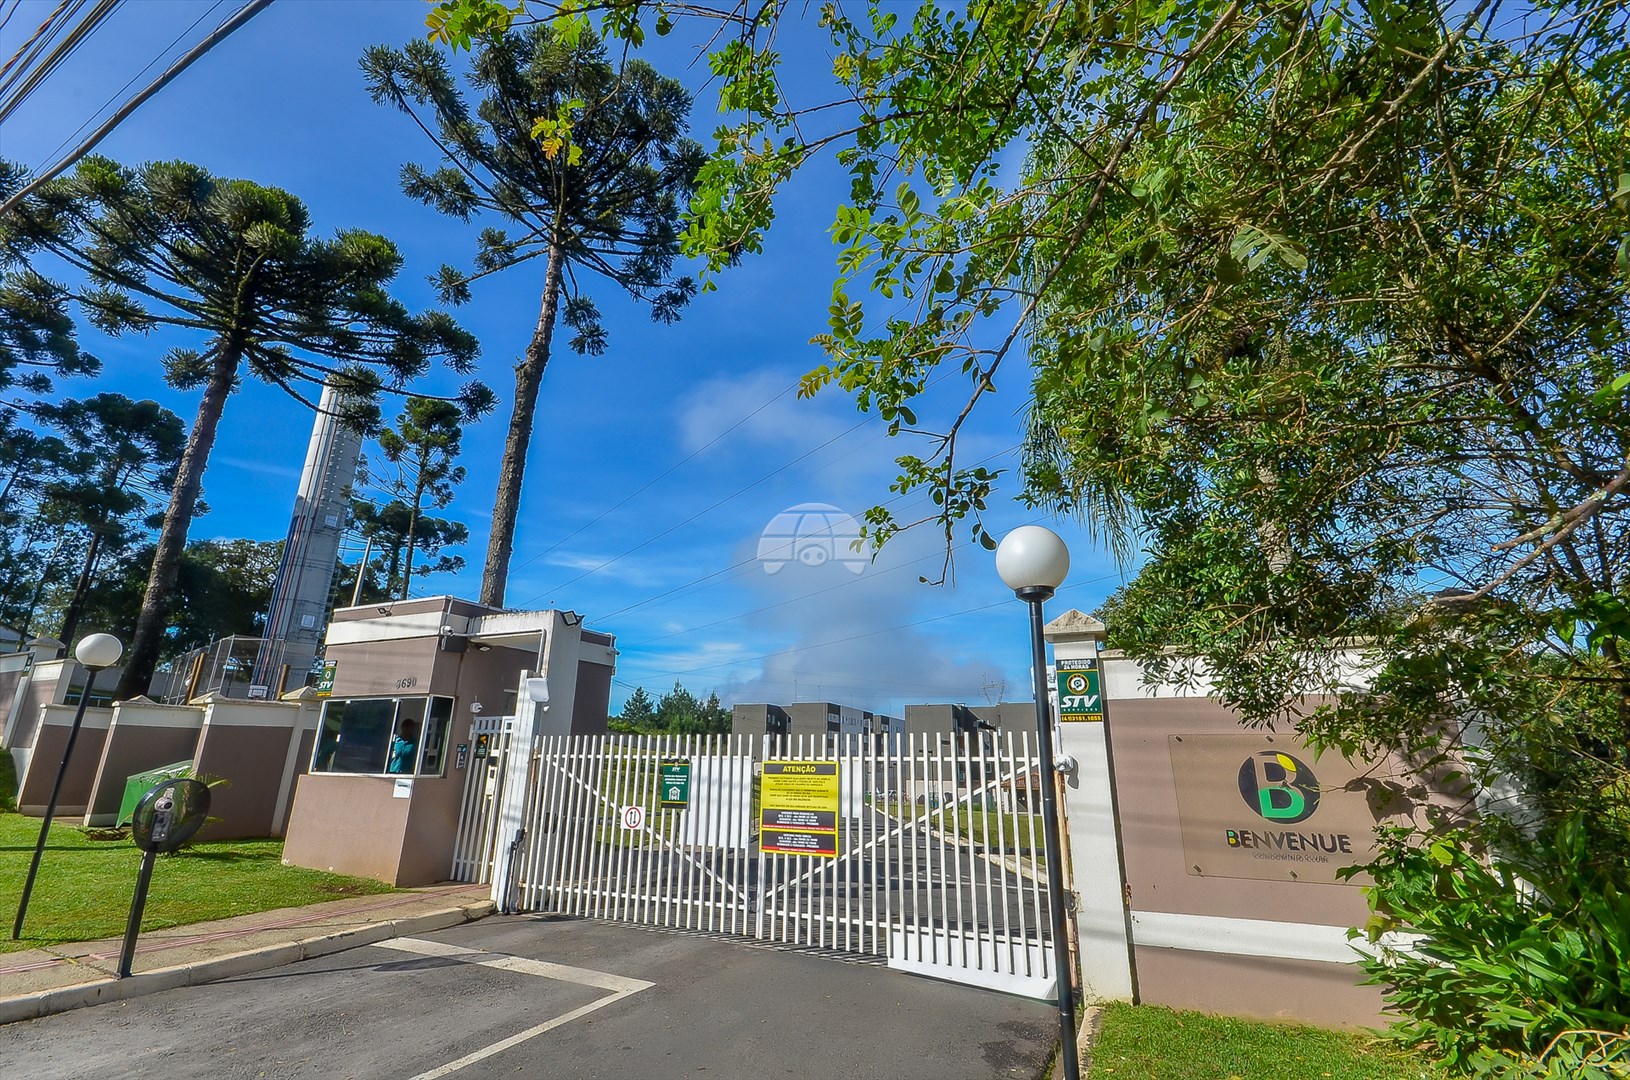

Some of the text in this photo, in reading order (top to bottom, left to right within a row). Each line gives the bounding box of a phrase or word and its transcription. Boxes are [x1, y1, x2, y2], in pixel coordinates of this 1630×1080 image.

[1060, 695, 1099, 708] STV
[783, 765, 816, 774] ATENÇÃO
[1226, 829, 1353, 854] BENVENUE
